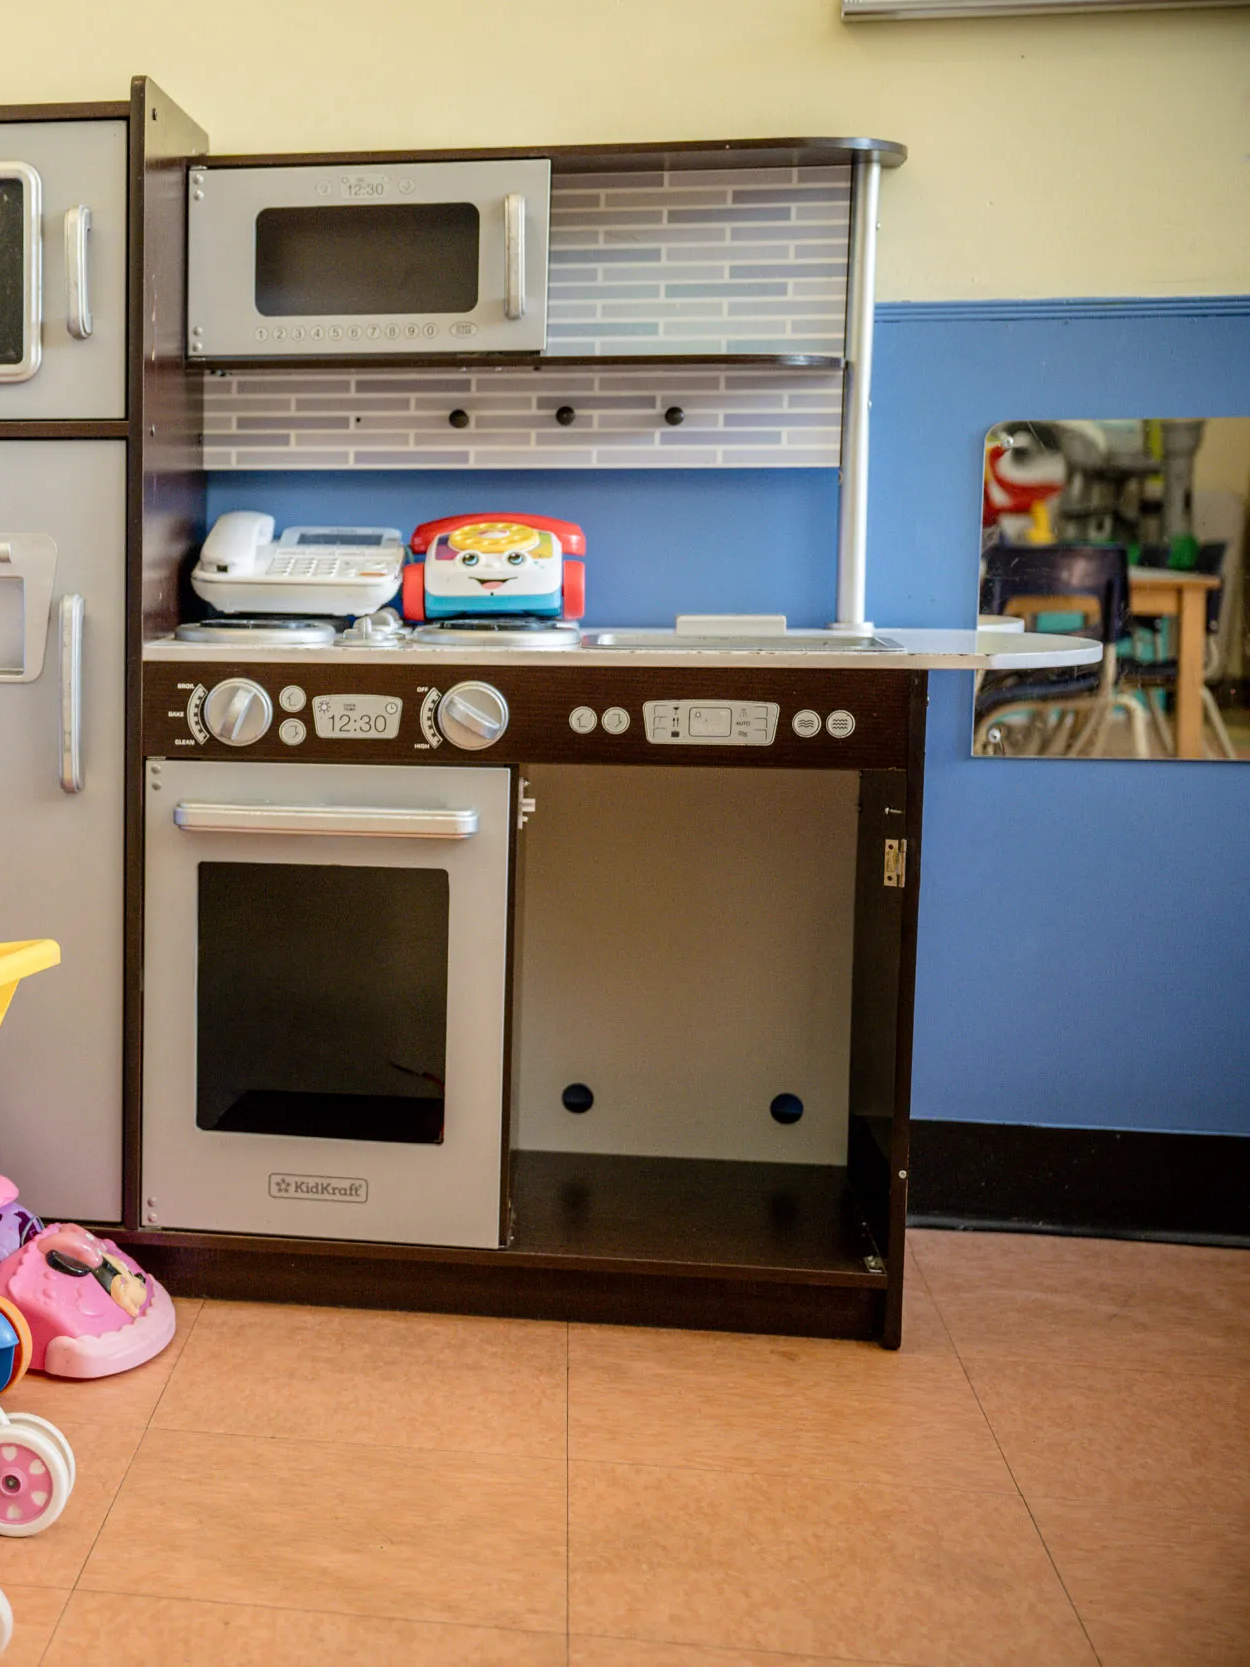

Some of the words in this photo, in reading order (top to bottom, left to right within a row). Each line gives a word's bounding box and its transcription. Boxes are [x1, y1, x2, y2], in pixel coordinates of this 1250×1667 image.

[348, 183, 384, 196] 12:30
[328, 714, 387, 733] 12:30
[293, 1180, 361, 1198] KidKraft
